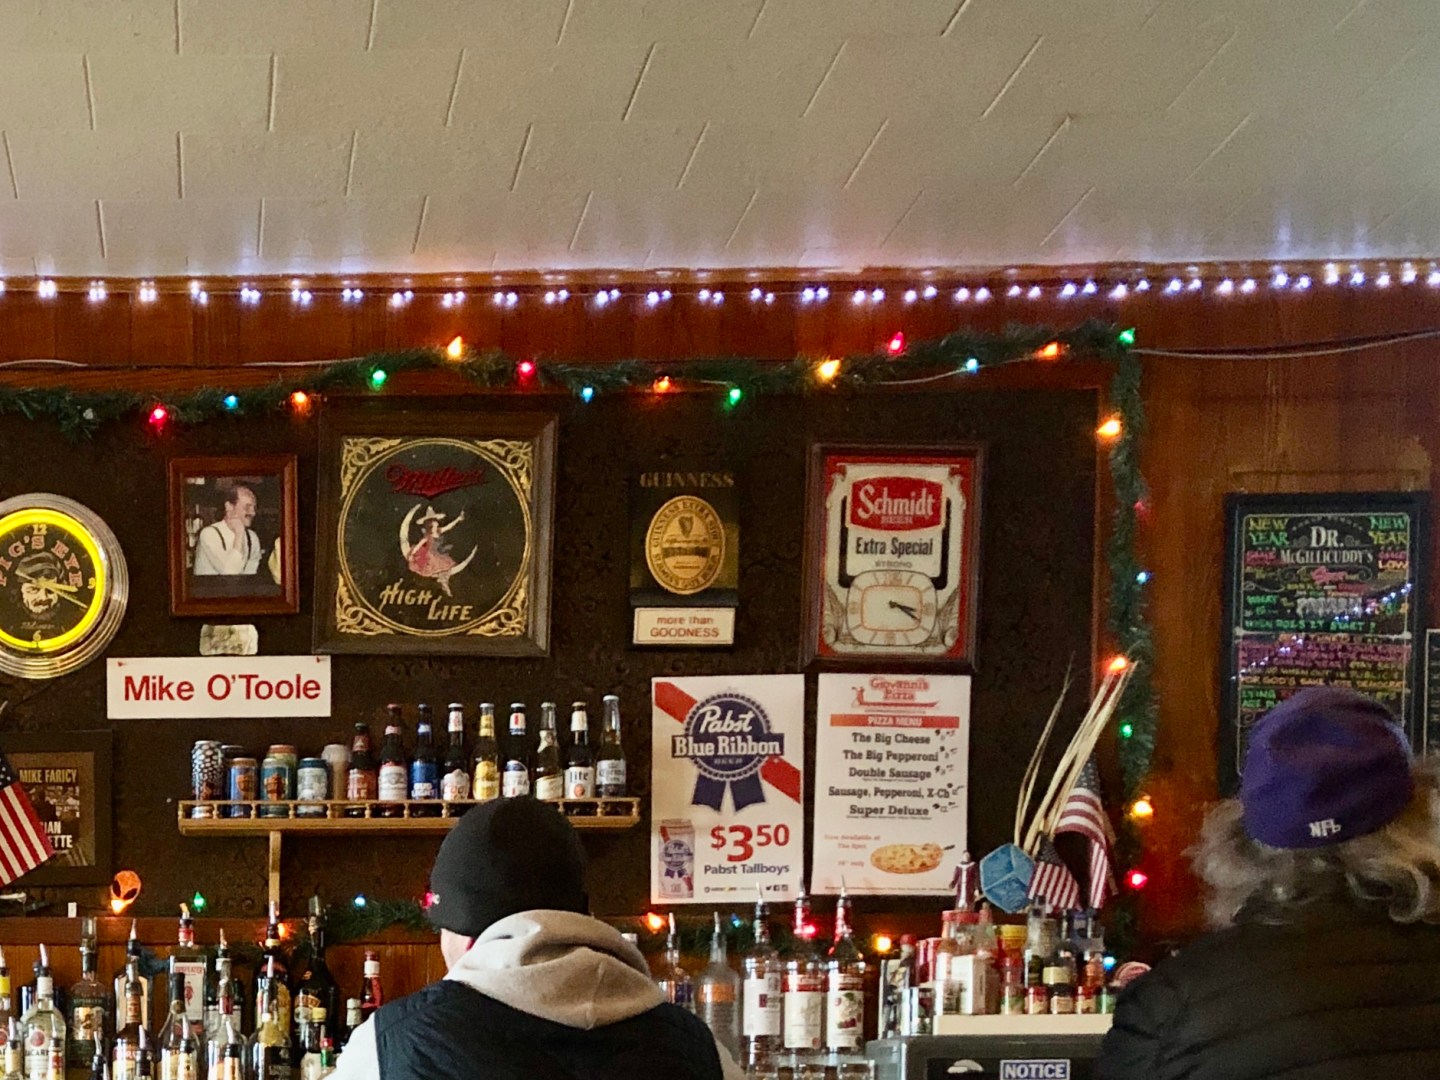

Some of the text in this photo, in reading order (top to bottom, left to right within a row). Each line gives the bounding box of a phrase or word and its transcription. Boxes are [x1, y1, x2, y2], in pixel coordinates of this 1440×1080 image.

[640, 472, 735, 488] GUINNESS
[857, 484, 937, 520] Schmidt
[855, 537, 934, 559] Extra Special
[51, 540, 84, 588] EYE
[650, 627, 720, 638] GOODNESS
[123, 673, 321, 701] Mike O'Toole
[699, 705, 756, 734] Pabst
[674, 734, 781, 757] Blue Ribbon
[852, 732, 872, 743] The
[874, 733, 892, 746] Big
[894, 734, 931, 744] Cheese
[843, 750, 863, 760] The
[866, 750, 883, 762] Big
[886, 750, 939, 763] Pepperoni
[19, 768, 78, 784] MIKE FARICY
[849, 767, 886, 778] Double
[889, 768, 932, 781] Sausage
[849, 804, 885, 817] Super
[888, 805, 929, 816] Deluxe
[1309, 818, 1342, 839] NFL
[704, 864, 790, 877] Pabst Tallboys
[1005, 1063, 1066, 1078] NOTICE
